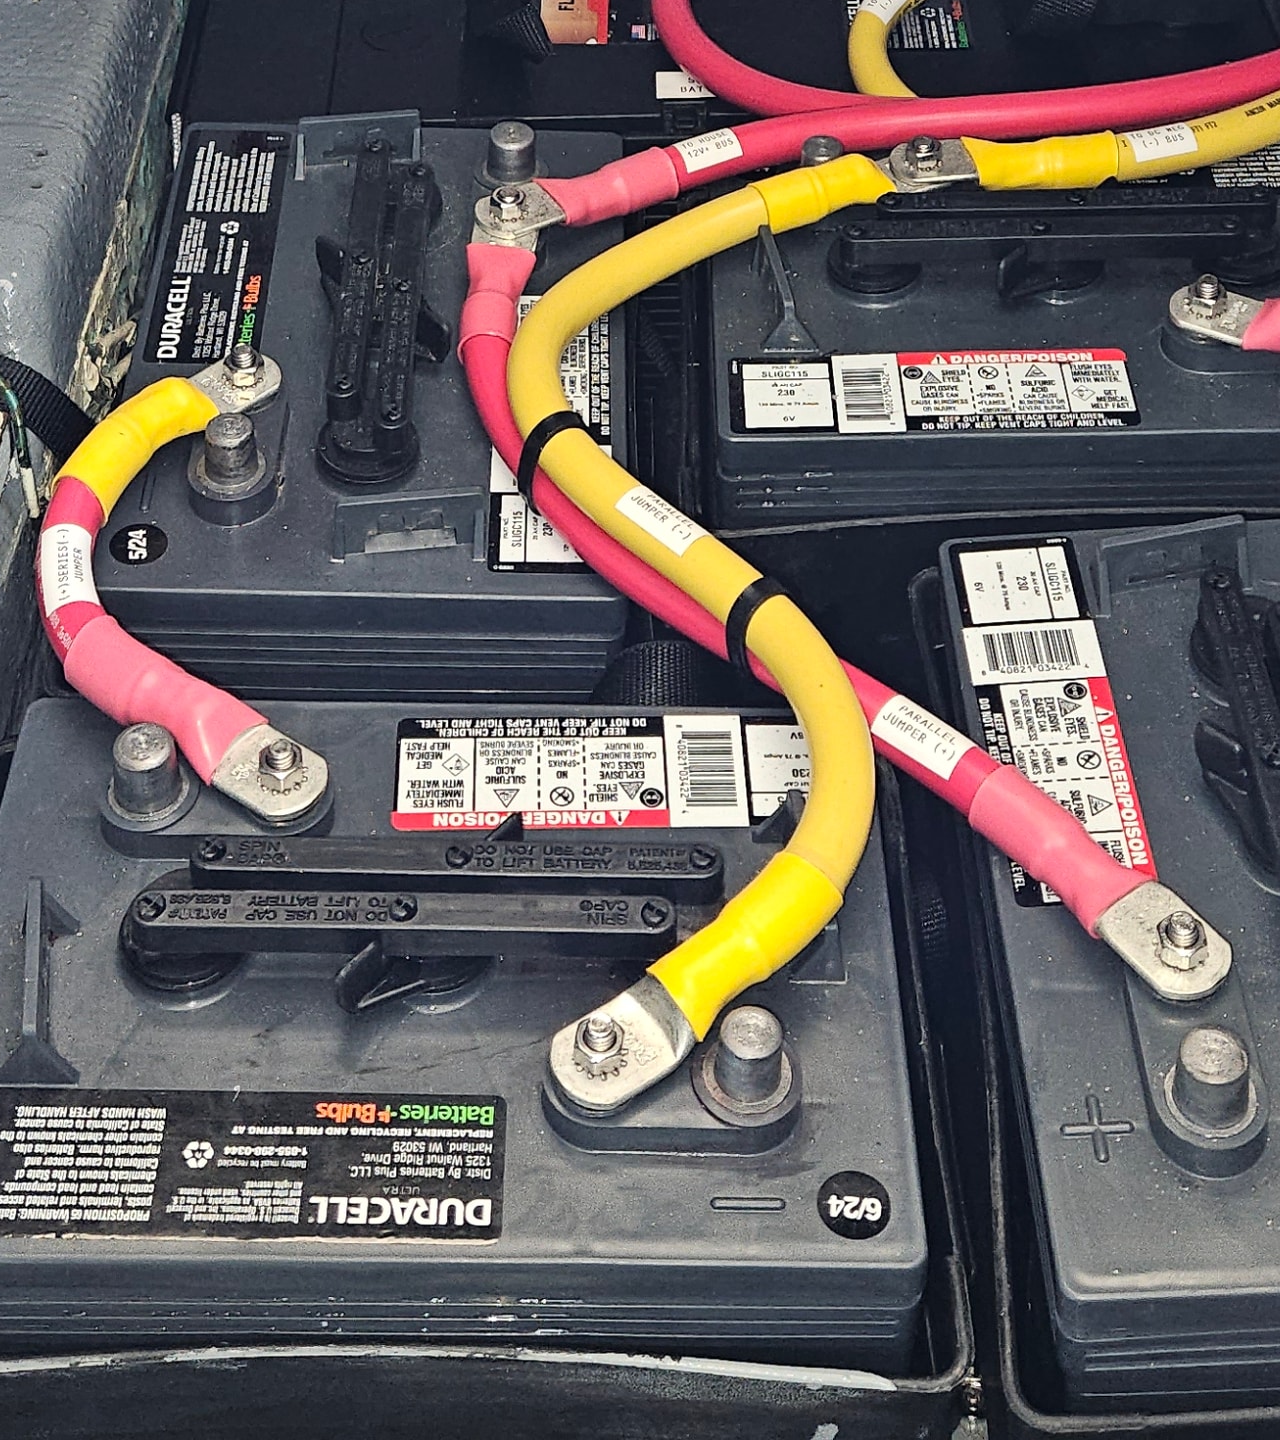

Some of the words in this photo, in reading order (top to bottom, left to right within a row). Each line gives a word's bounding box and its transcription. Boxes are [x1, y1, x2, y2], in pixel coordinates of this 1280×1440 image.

[681, 141, 694, 150] TO
[698, 131, 728, 144] HOUSE
[1129, 132, 1145, 141] TO
[1165, 132, 1185, 144] BUS
[687, 146, 710, 159] 12V+
[714, 137, 734, 150] BUS
[156, 274, 192, 359] DURACELL
[951, 352, 1095, 364] DANGER/POISON
[760, 369, 809, 378] SLIGC115
[776, 388, 796, 397] 230
[783, 415, 796, 423] 6V
[630, 495, 669, 524] JUMPER
[646, 493, 694, 530] PARALLEL
[511, 510, 524, 548] SLIGC115
[127, 529, 149, 561] 5/24
[72, 548, 84, 583] JUMPER
[973, 581, 985, 594] 6V
[1016, 575, 1030, 592] 230
[1044, 561, 1065, 603] SLIGC115
[881, 712, 928, 745] JUMPER
[897, 703, 958, 747] PARALLEL
[405, 751, 443, 761] MEDICAL
[484, 774, 527, 785] SULFURIC
[598, 770, 647, 780] EXPLOSIVE
[405, 789, 465, 799] IMMEDIATELY
[1100, 725, 1149, 867] DANGER/POISON
[433, 811, 607, 827] DANGERPOISON
[392, 1141, 425, 1153] 53029
[428, 1142, 444, 1153] WI
[446, 1141, 493, 1154] Hartland,
[361, 1152, 391, 1165] Drive,
[393, 1153, 424, 1167] Ridge
[426, 1154, 464, 1167] Walnut
[466, 1155, 492, 1167] 1325
[349, 1164, 372, 1178] LLC,
[373, 1165, 397, 1178] Plus
[398, 1165, 445, 1180] Batteries
[447, 1166, 462, 1179] By
[464, 1166, 492, 1180] Distr.
[381, 1185, 421, 1196] ULTRA
[307, 1194, 493, 1227] DURACELL
[829, 1193, 878, 1219] 6/24
